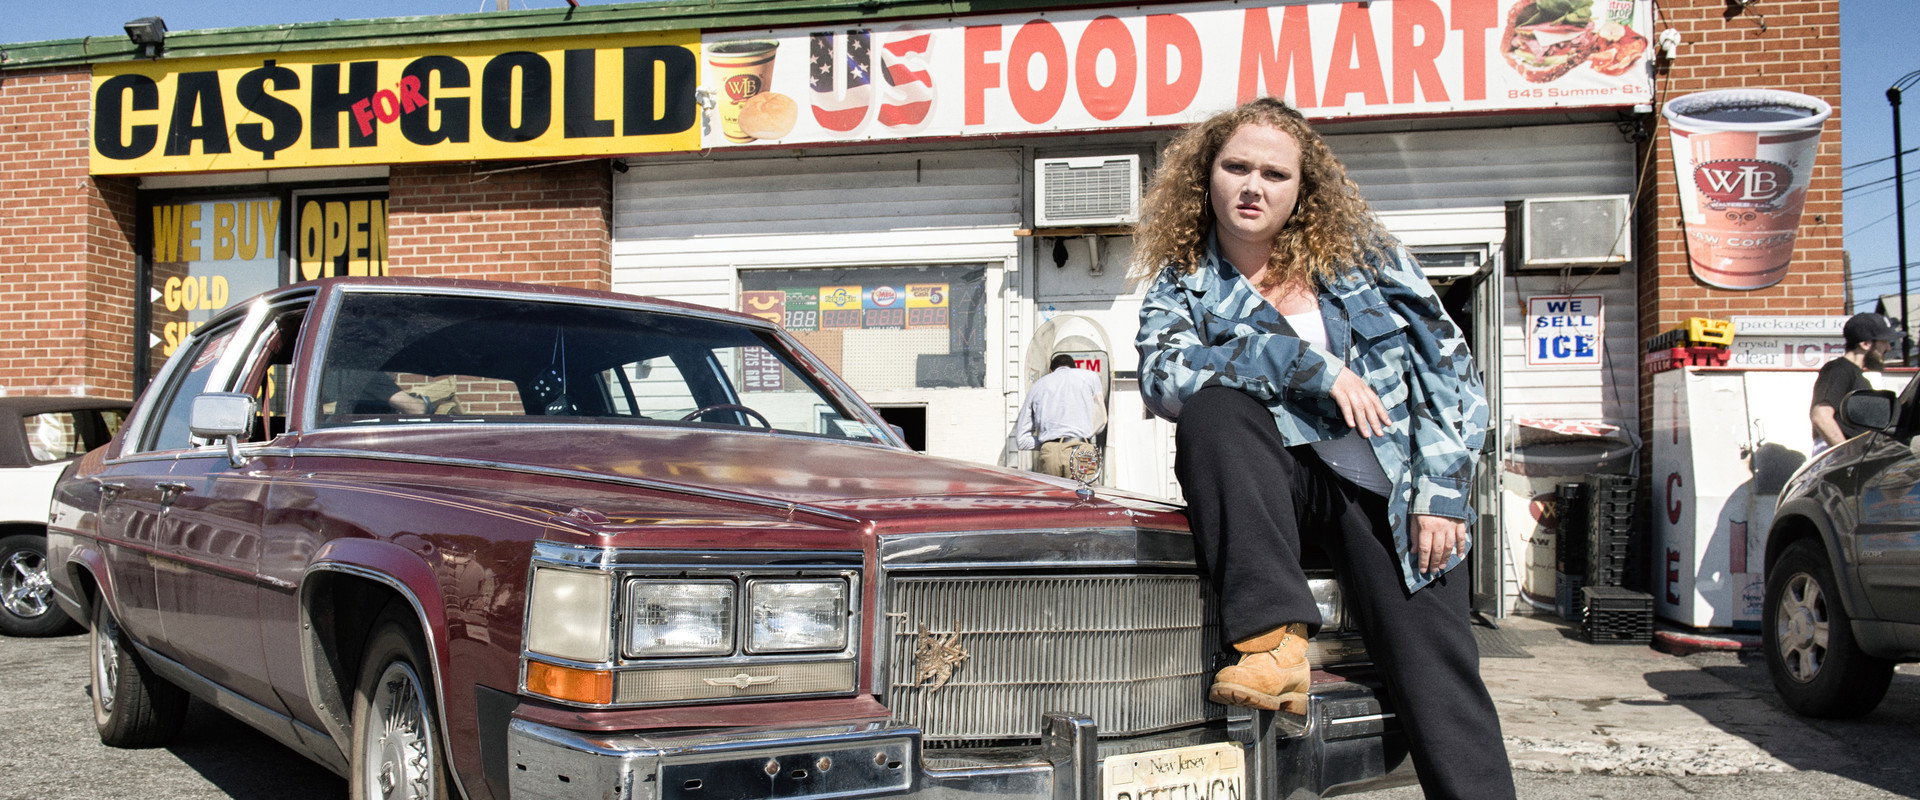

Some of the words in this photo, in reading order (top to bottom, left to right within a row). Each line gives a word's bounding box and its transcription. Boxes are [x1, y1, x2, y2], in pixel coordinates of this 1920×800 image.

[808, 24, 938, 136] US
[964, 14, 1203, 126] FOOD
[1236, 0, 1498, 108] MART
[1507, 88, 1544, 99] 845
[1547, 86, 1618, 97] Summer
[1622, 84, 1648, 94] St.
[95, 59, 379, 161] CA$H
[351, 74, 429, 138] FOR
[399, 44, 698, 145] GOLD
[152, 203, 201, 263] WE
[213, 200, 282, 261] BUY
[163, 275, 229, 312] GOLD
[1547, 300, 1582, 313] WE
[1536, 315, 1593, 328] SELL
[1740, 318, 1826, 331] packaged
[1538, 334, 1594, 359] ICE
[1737, 340, 1779, 350] crystal
[744, 346, 760, 367] SIZE
[1735, 349, 1779, 365] clear
[1074, 359, 1101, 372] TM
[745, 370, 760, 387] ANY
[1150, 757, 1175, 775] New
[1177, 755, 1207, 775] Jersey
